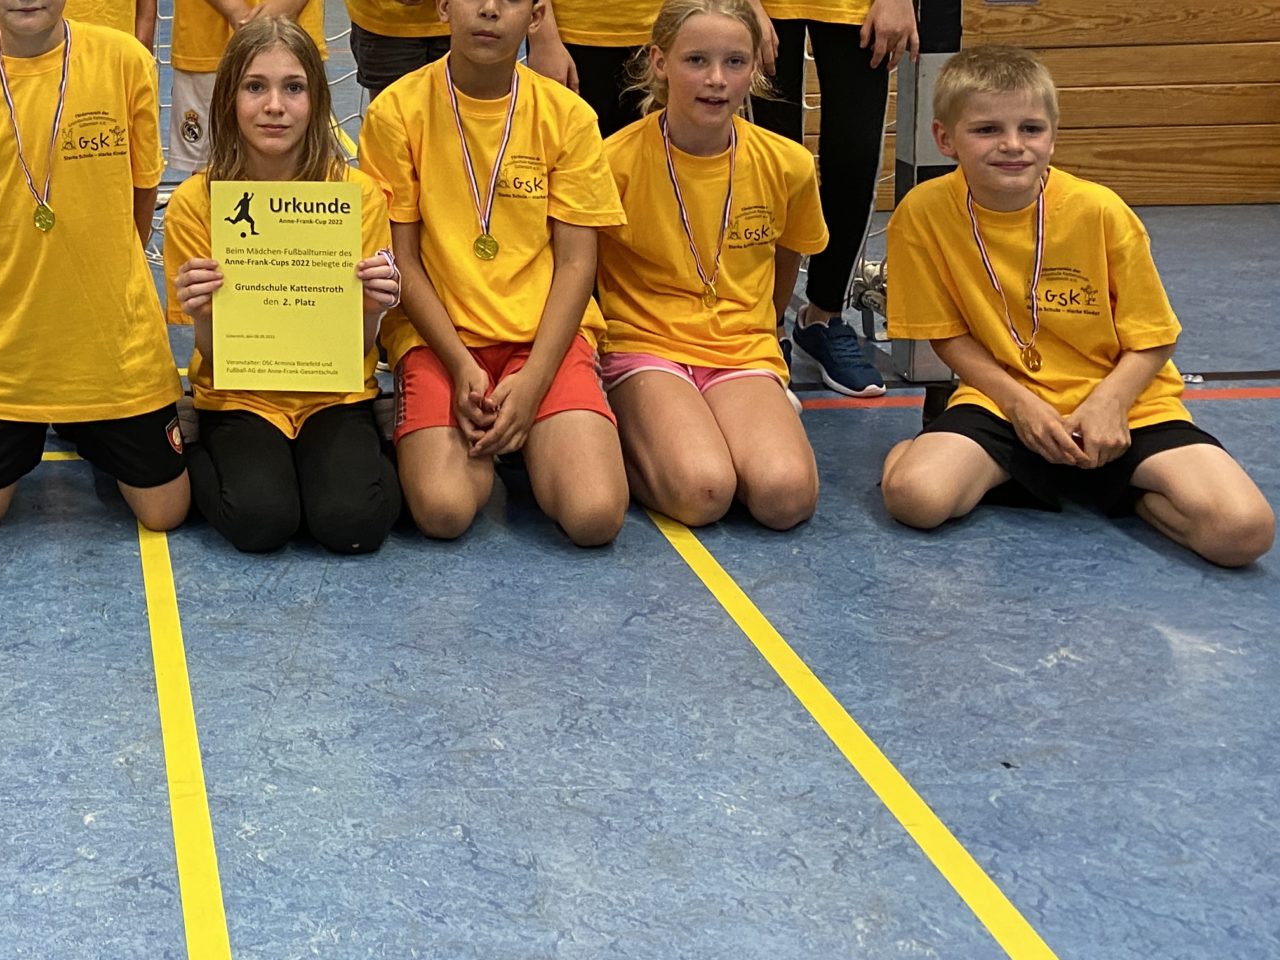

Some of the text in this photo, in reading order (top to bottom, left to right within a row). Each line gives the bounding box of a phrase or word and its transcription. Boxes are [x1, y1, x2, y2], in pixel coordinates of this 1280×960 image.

[78, 132, 110, 151] GSK
[513, 176, 543, 193] GSK
[269, 196, 351, 214] Urkunde
[278, 218, 327, 226] Anne-Frank-Cup
[744, 224, 770, 241] GSK
[225, 247, 352, 258] Beim Mädchen-Fußballturnier des
[224, 258, 354, 269] Anne-Frank-Cups 2022 belegte die
[234, 283, 344, 294] Grundschule Kattenstroth
[263, 297, 316, 307] den 2. Platz
[1045, 289, 1081, 307] GSK
